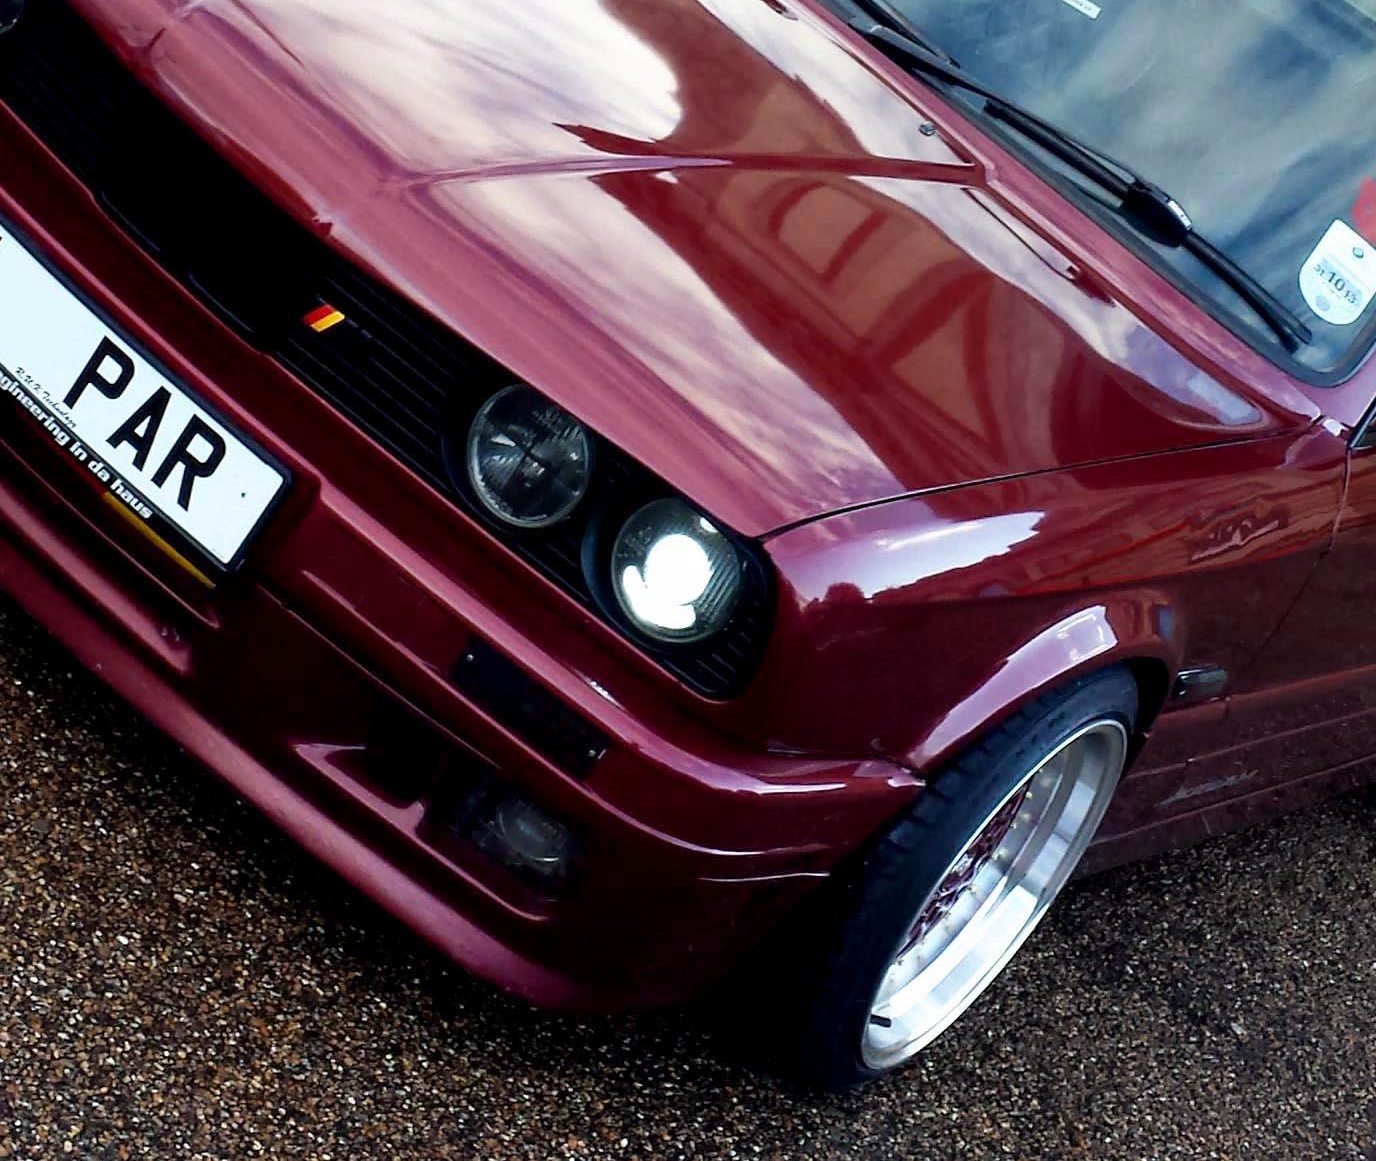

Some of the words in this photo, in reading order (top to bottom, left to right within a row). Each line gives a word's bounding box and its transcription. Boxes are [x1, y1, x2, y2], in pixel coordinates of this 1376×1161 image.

[1328, 271, 1345, 291] 10
[62, 335, 226, 512] PAR
[69, 441, 87, 461] in
[87, 460, 110, 482] da
[109, 479, 153, 519] haus
